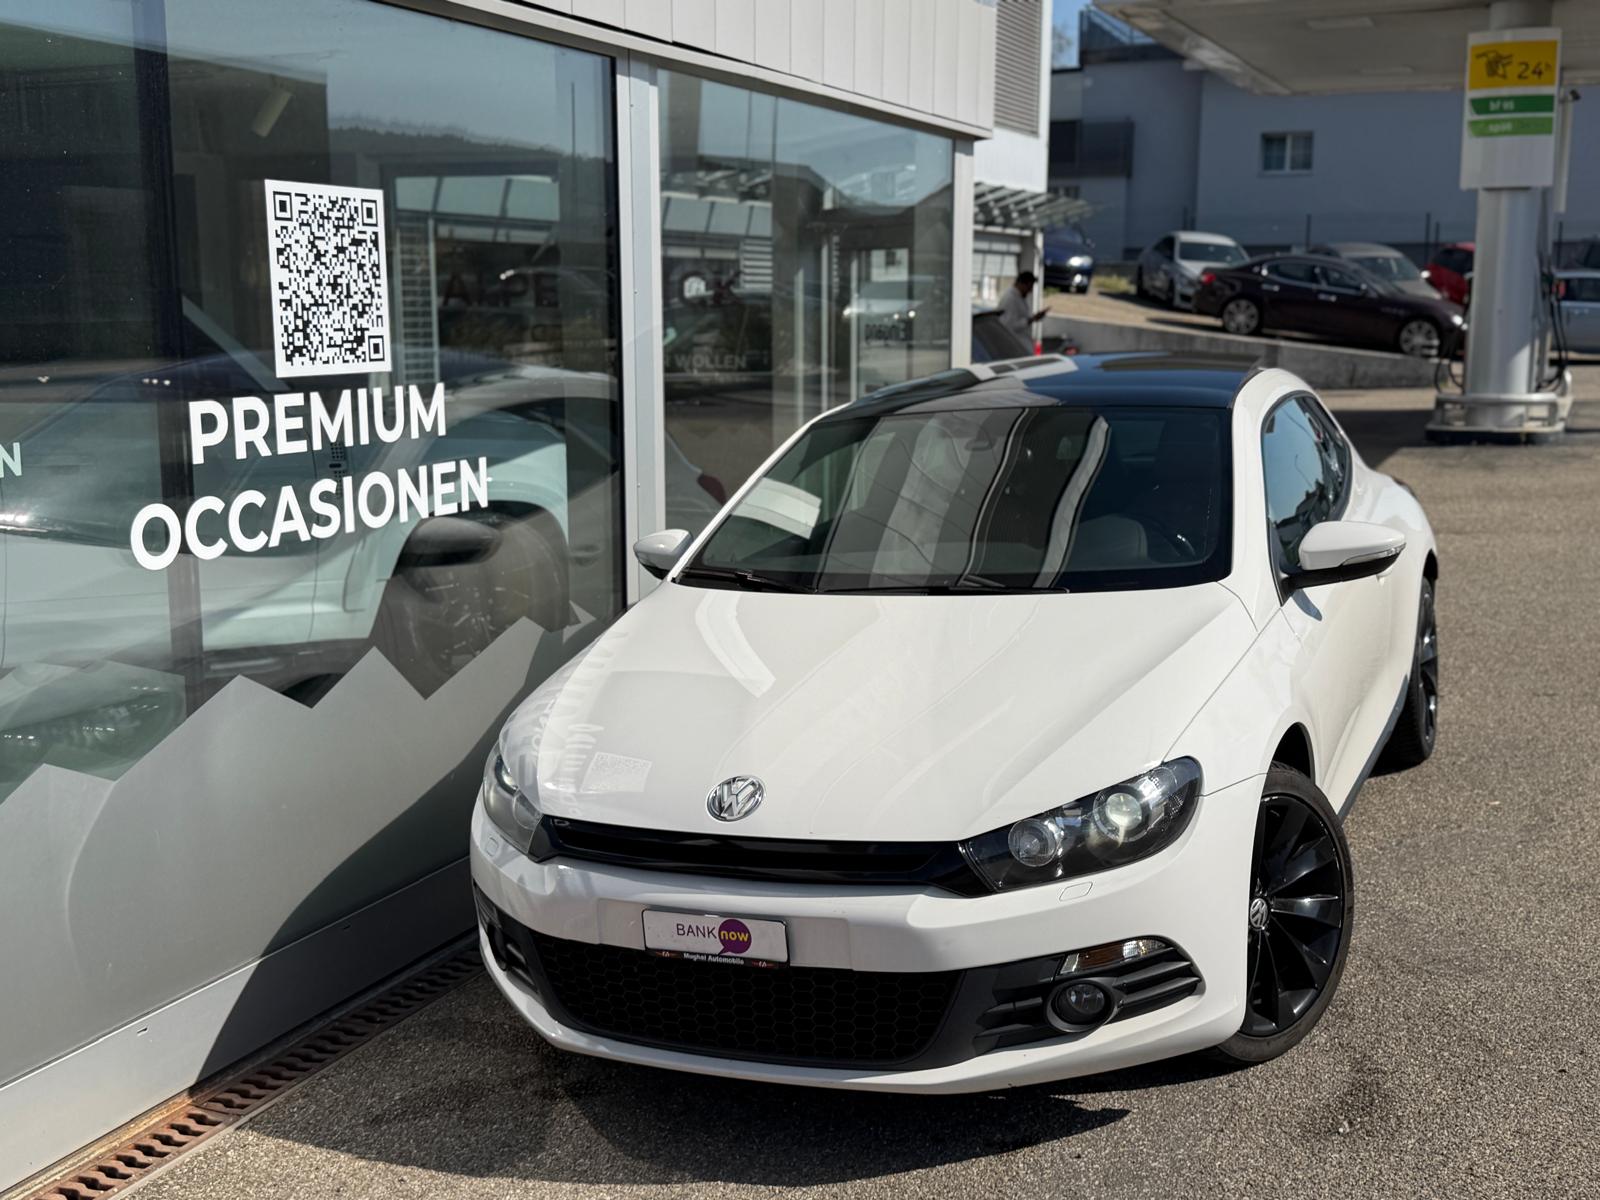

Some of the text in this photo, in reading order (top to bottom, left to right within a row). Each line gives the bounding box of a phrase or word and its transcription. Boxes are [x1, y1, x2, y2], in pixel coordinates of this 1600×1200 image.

[188, 383, 447, 465] PREMIUM
[130, 456, 490, 571] OCCASIONEN
[676, 923, 750, 942] BANK now
